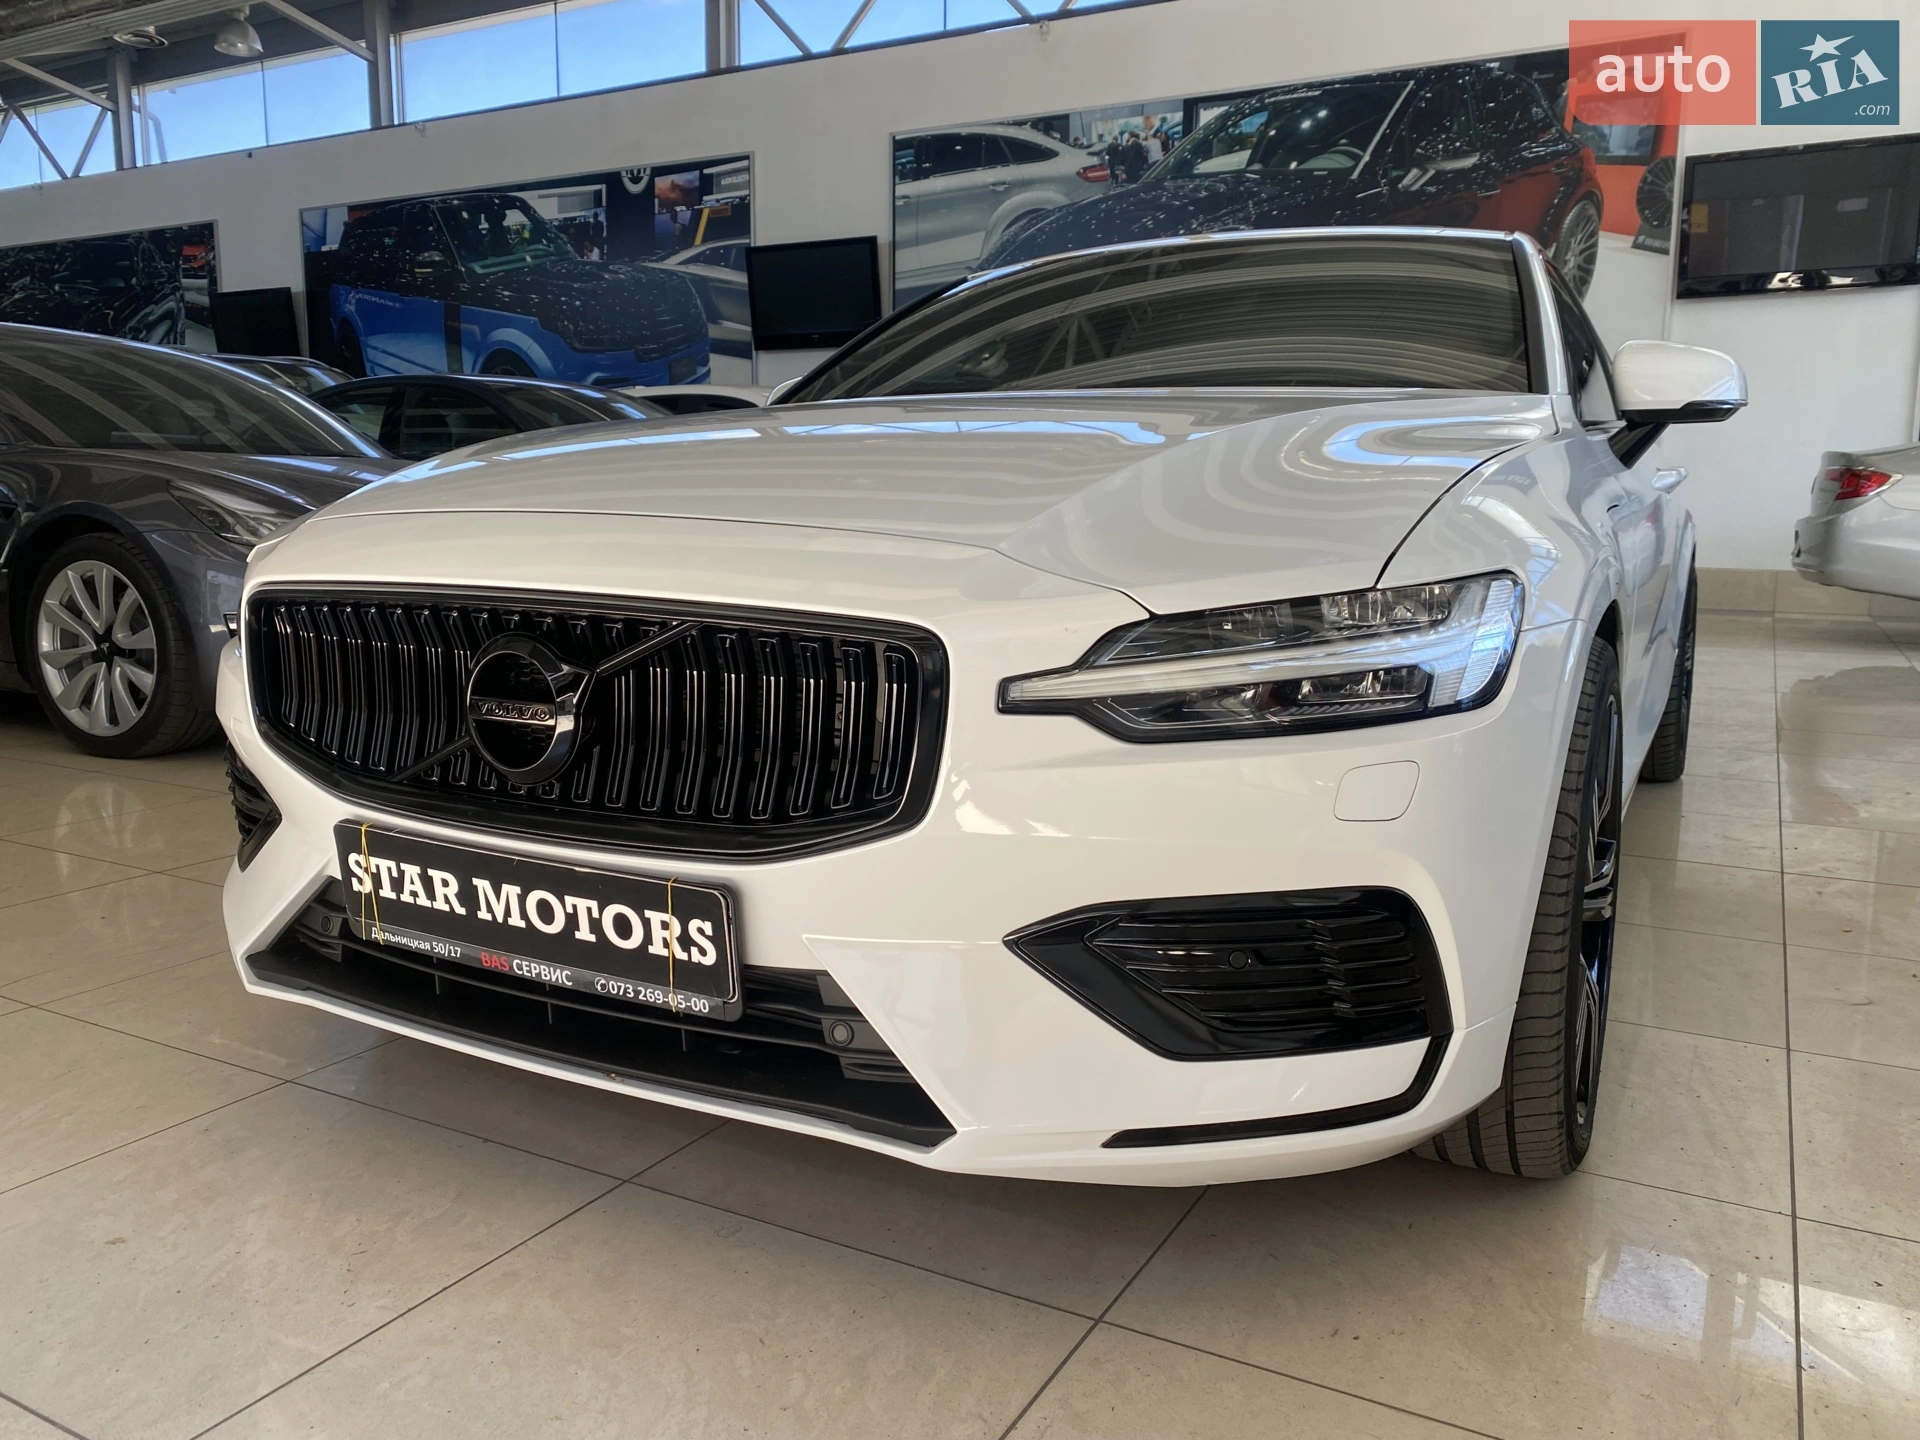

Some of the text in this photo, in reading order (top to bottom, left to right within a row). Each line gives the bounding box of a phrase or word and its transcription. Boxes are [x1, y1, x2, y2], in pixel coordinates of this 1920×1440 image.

[478, 701, 550, 721] VOLVO
[347, 852, 717, 966] STAR MOTORS
[371, 926, 461, 958] Дальницкая 50/17
[480, 951, 573, 985] BAS СЕРВИС
[609, 982, 710, 1014] 073 269-05-00
